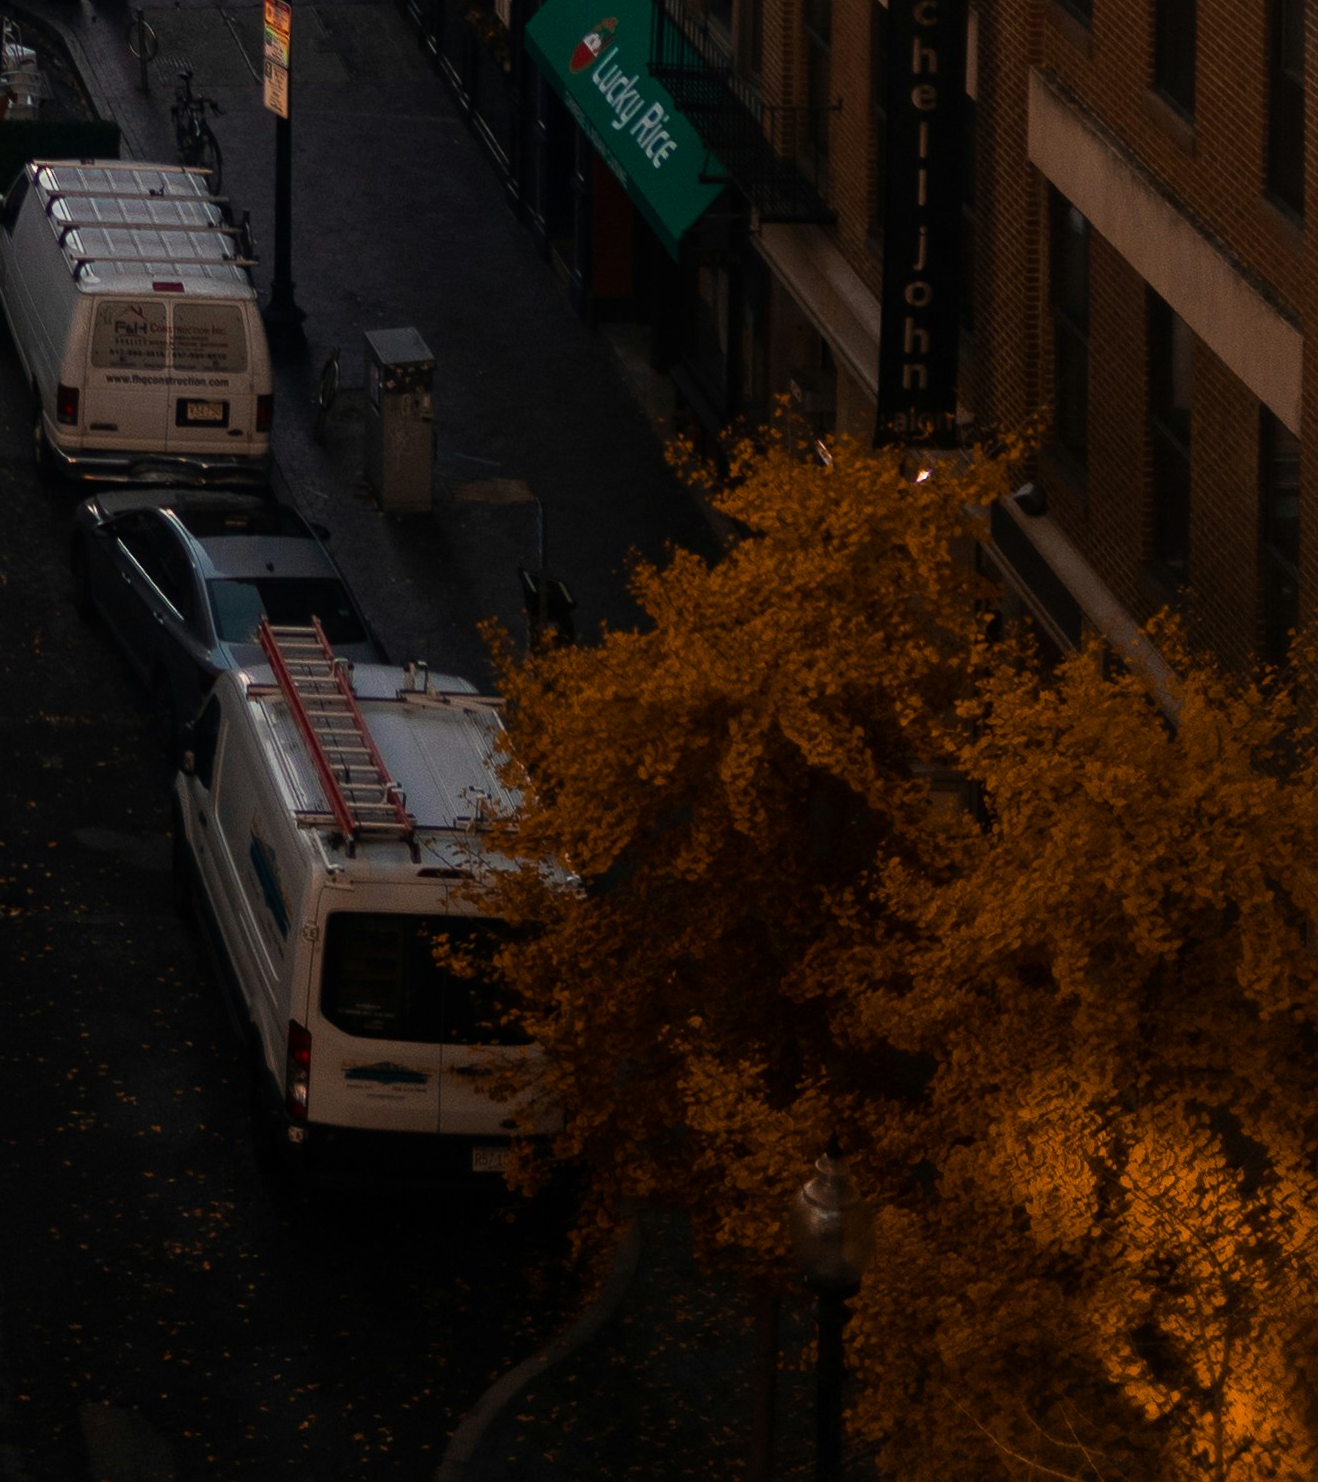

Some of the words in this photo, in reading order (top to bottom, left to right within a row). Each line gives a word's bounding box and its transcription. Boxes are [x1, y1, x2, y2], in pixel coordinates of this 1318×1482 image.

[592, 46, 645, 131] Lucky
[630, 100, 678, 169] Rice
[901, 224, 934, 391] john
